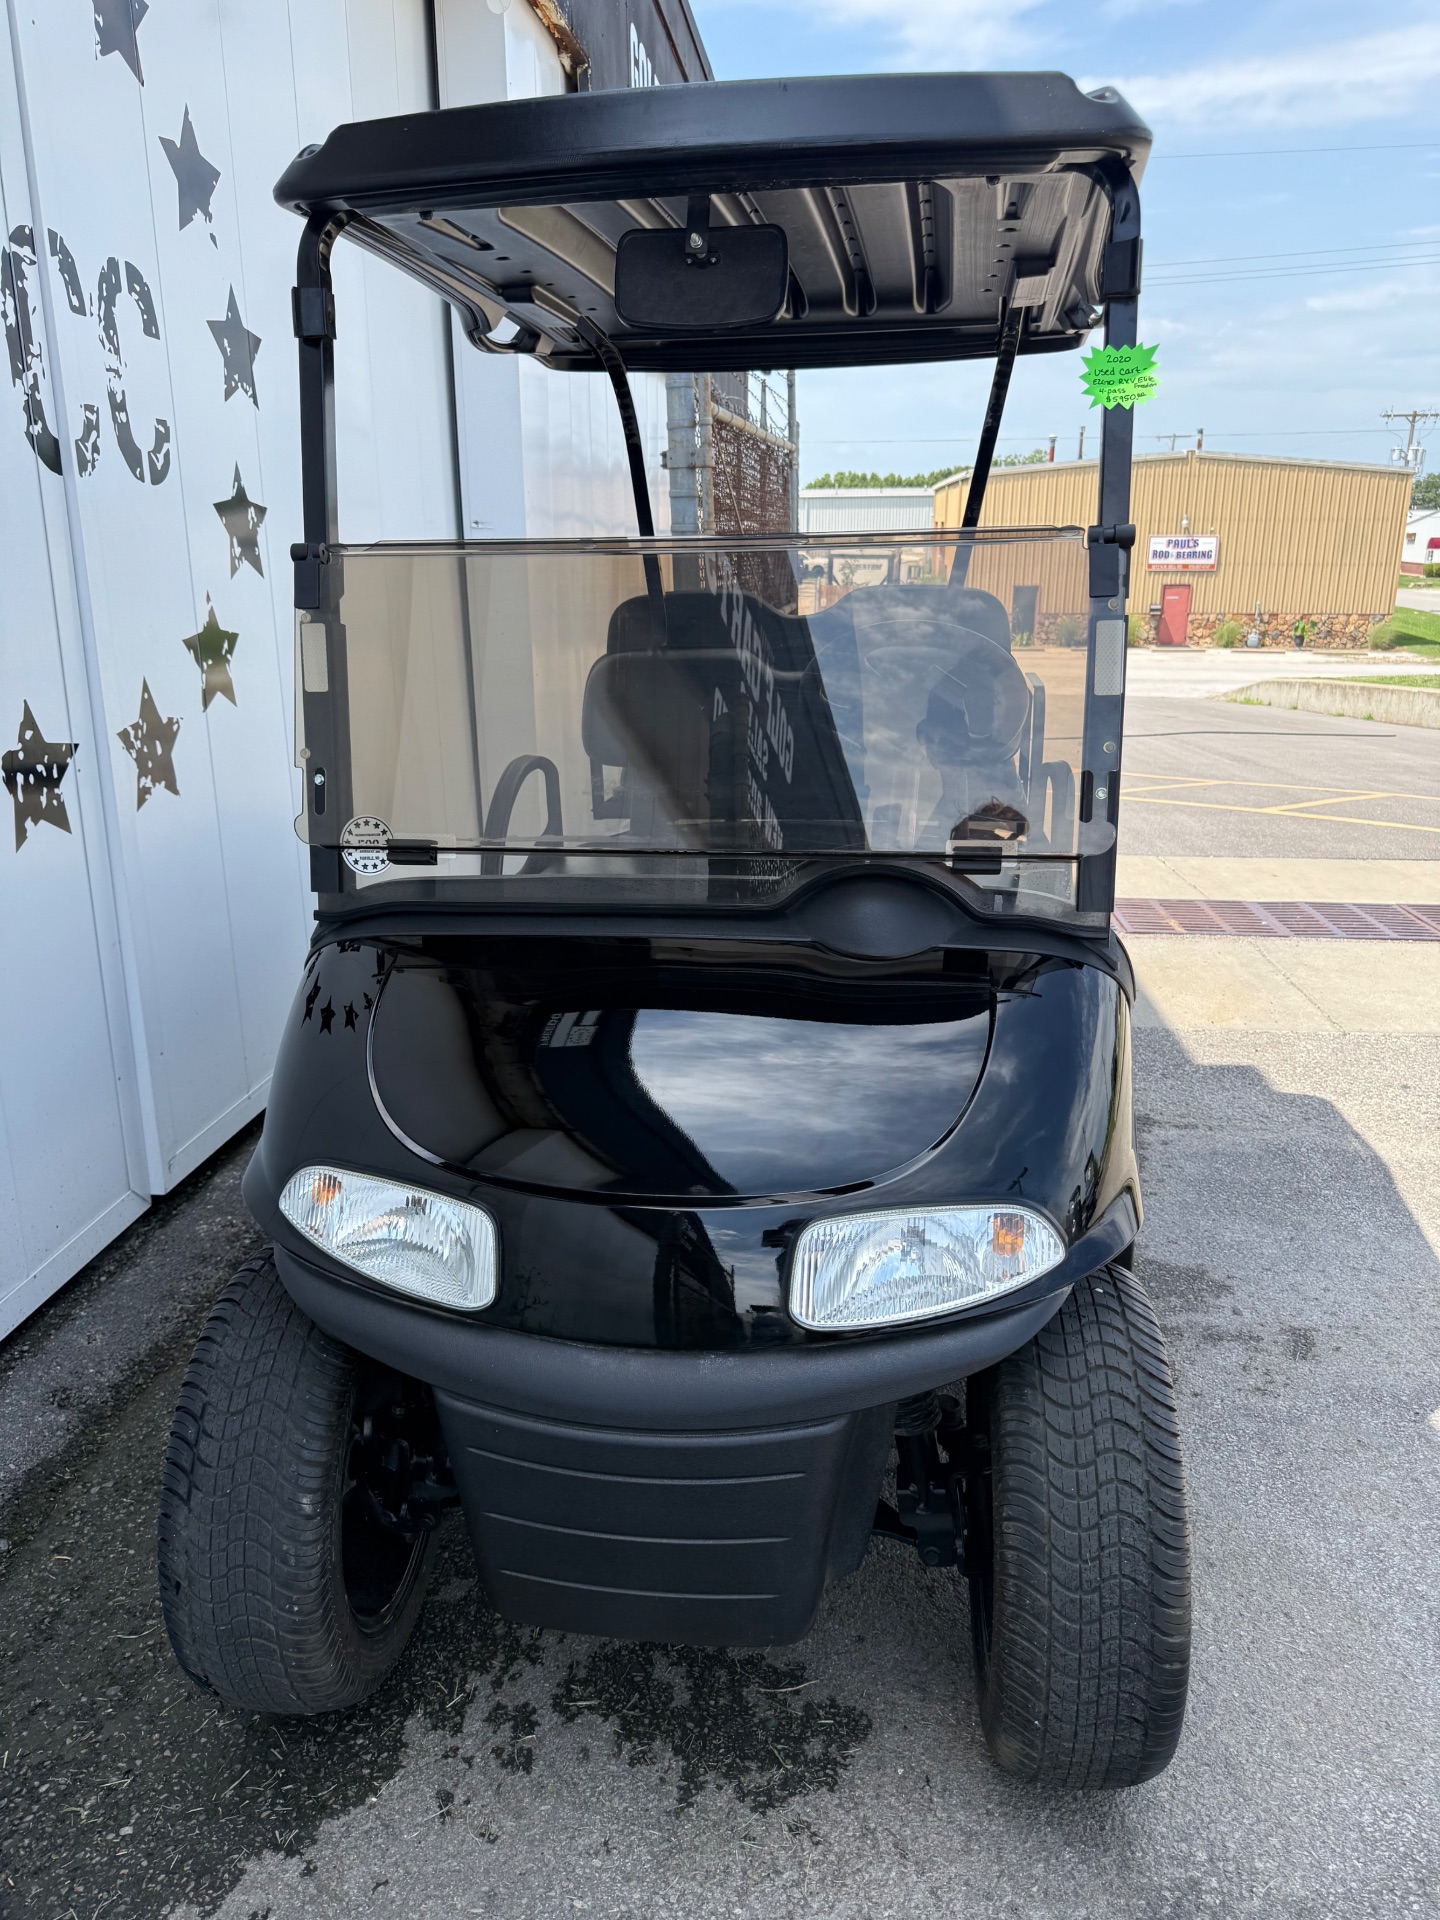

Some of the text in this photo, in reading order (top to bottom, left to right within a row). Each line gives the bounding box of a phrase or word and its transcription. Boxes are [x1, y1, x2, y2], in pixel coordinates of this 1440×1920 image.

[1106, 354, 1132, 363] 2020
[1166, 538, 1200, 549] PAUL'S
[1152, 549, 1170, 560] ROD
[1176, 549, 1213, 560] BEARING
